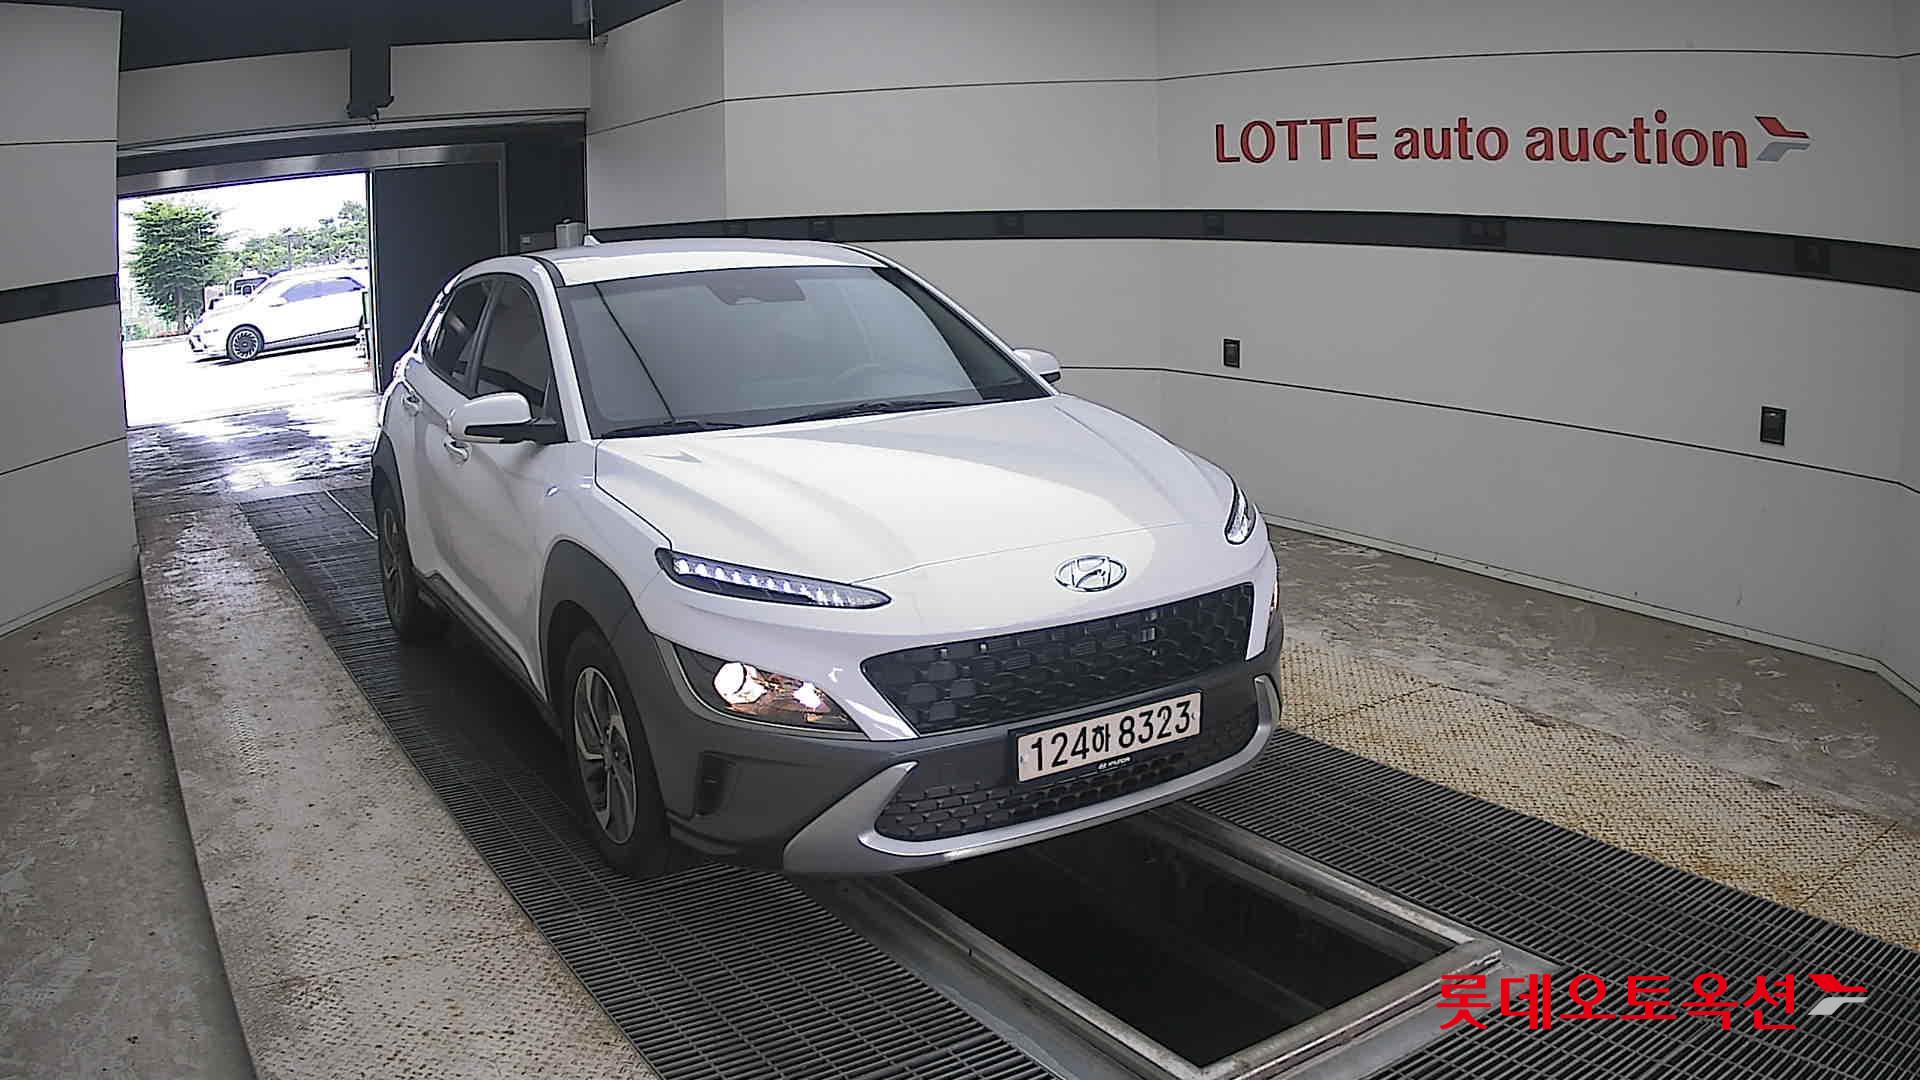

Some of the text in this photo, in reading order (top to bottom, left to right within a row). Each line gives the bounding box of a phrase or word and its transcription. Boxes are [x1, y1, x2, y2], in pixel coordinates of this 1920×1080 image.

[1215, 109, 1748, 168] LOTTE auto auction
[1031, 700, 1191, 771] 124하 8323
